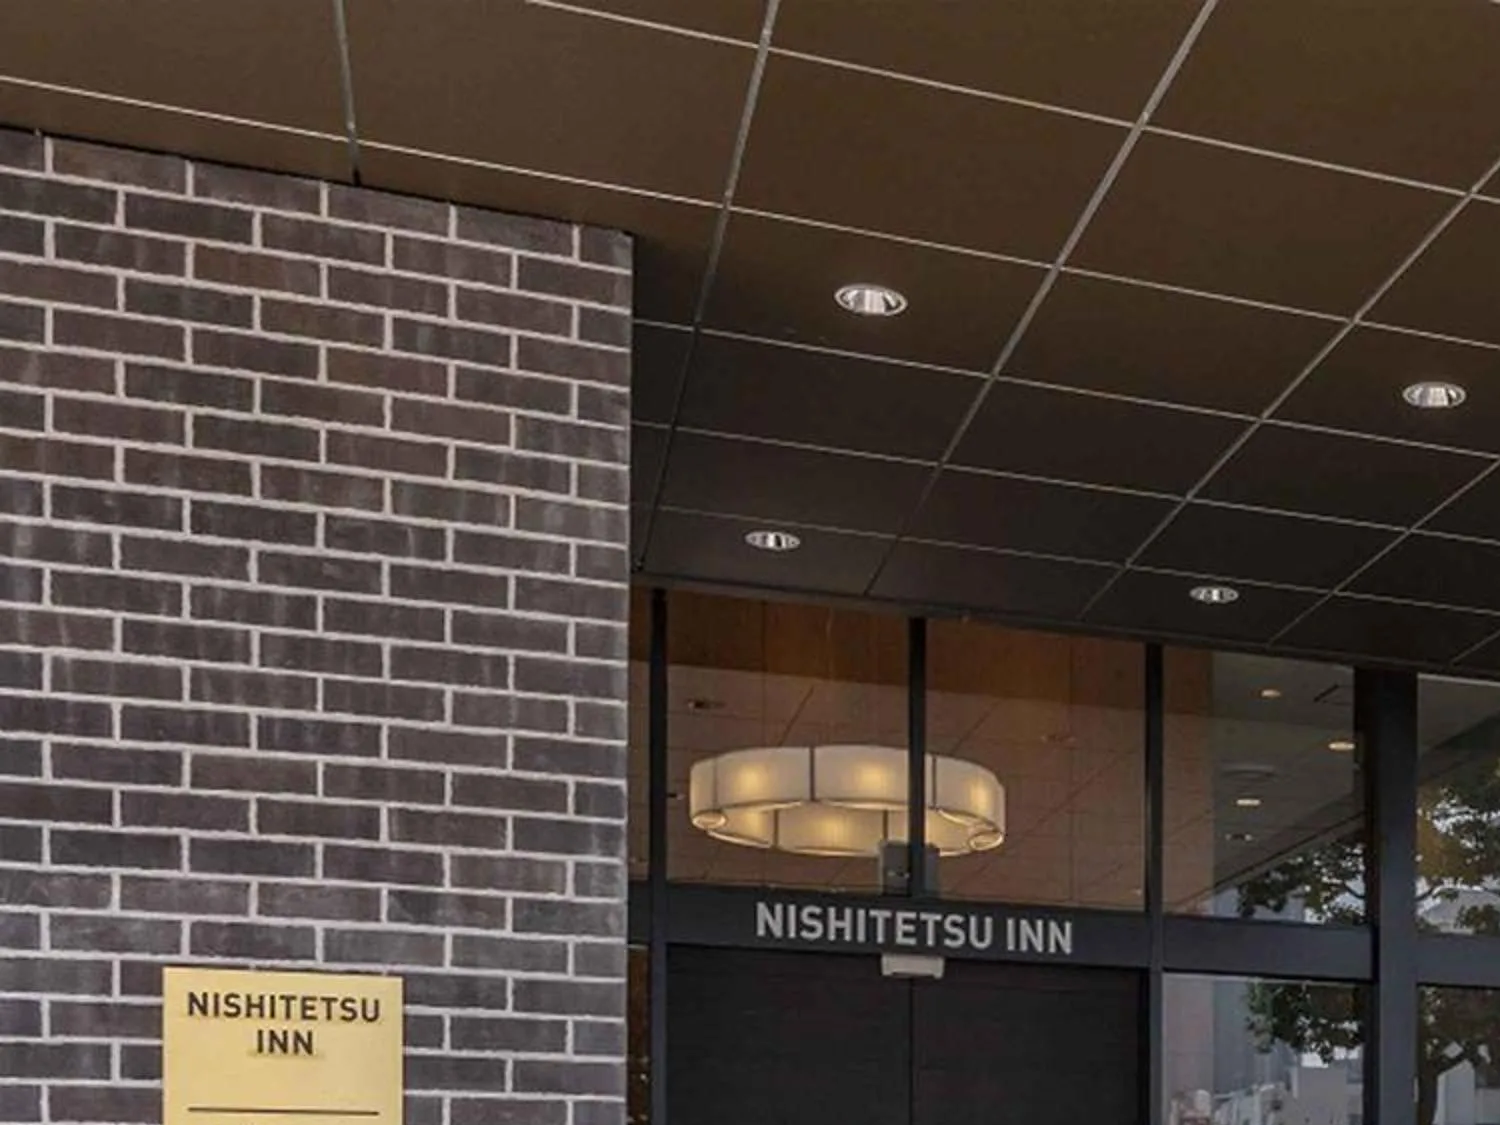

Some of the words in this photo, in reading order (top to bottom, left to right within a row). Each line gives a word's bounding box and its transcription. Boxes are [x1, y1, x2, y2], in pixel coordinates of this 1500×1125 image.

[756, 901, 993, 949] NISHITETSU
[1006, 917, 1073, 955] INN
[187, 991, 380, 1023] NISHITETSU
[256, 1029, 314, 1056] INN
